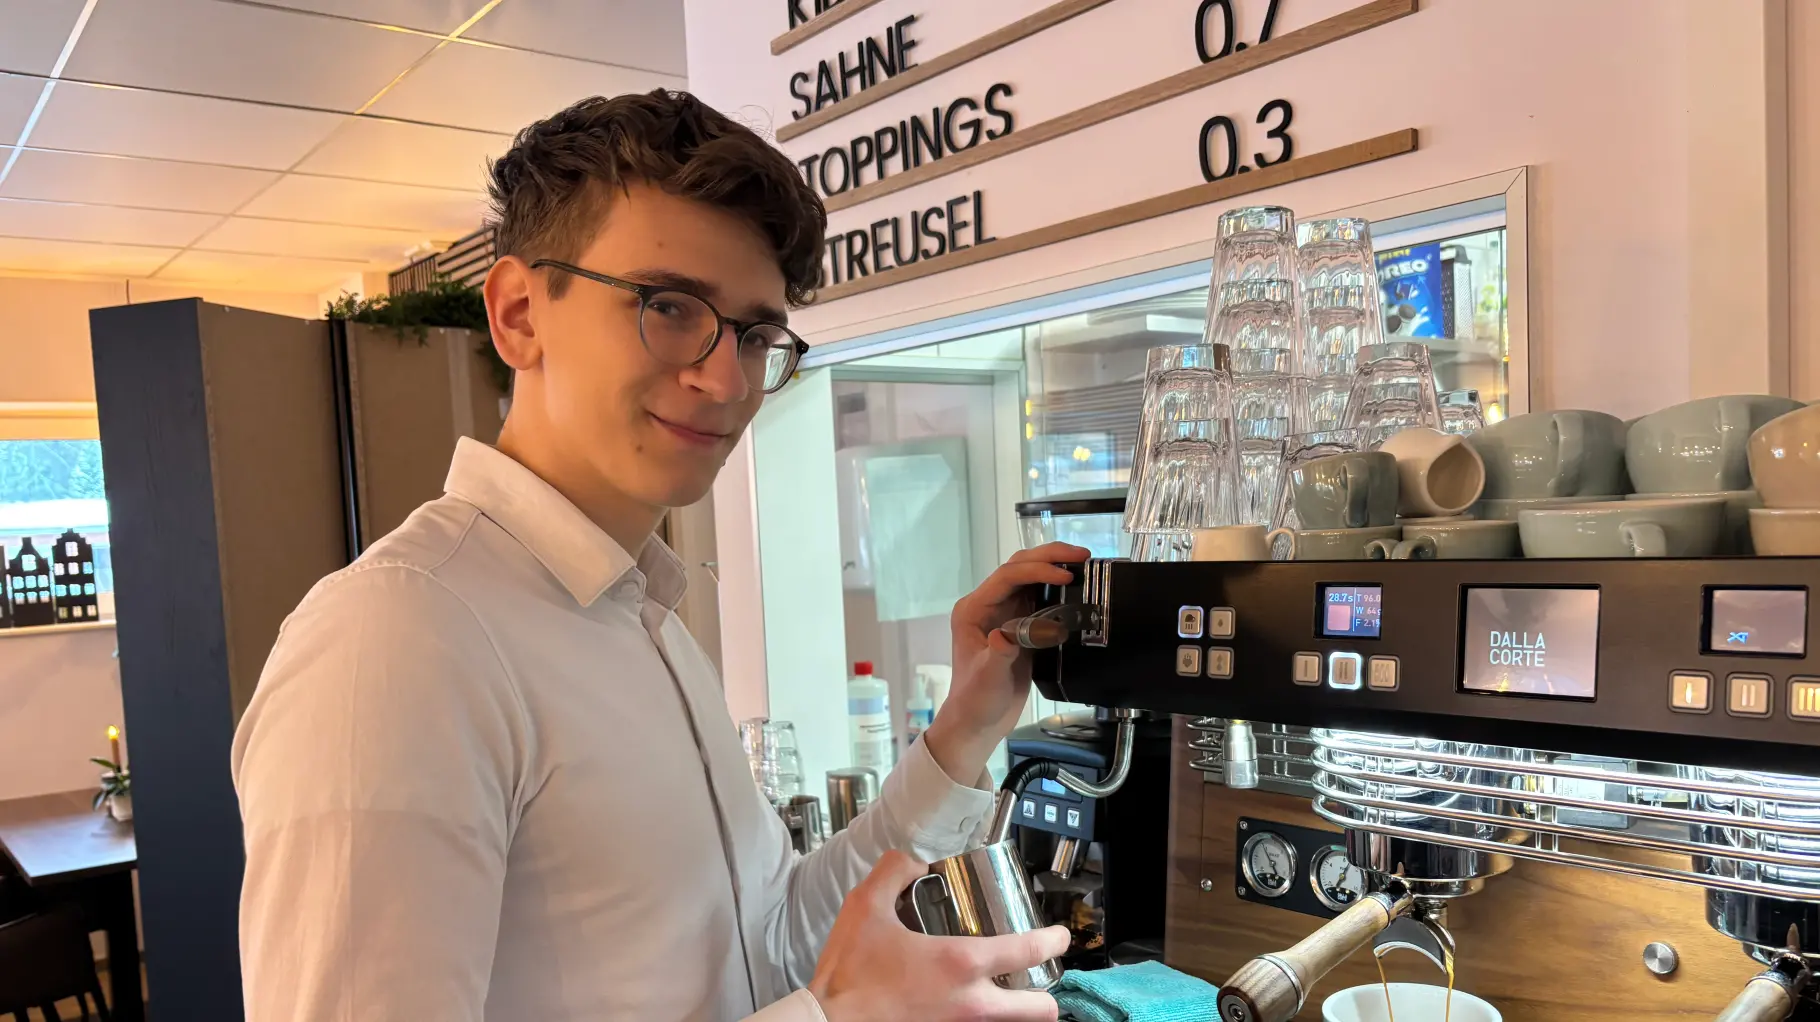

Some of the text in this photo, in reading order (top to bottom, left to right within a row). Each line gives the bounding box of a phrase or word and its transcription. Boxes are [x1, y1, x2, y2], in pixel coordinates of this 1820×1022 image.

[789, 15, 919, 121] SAHNE
[799, 83, 1014, 198] TOPPINGS
[1199, 99, 1293, 182] 0.3
[820, 190, 997, 288] TREUSEL
[1328, 593, 1354, 602] 28.7s
[1356, 594, 1381, 603] T 96.0
[1355, 606, 1364, 614] W
[1355, 618, 1361, 627] F
[1490, 631, 1546, 649] DALLA
[1490, 649, 1546, 667] CORTE
